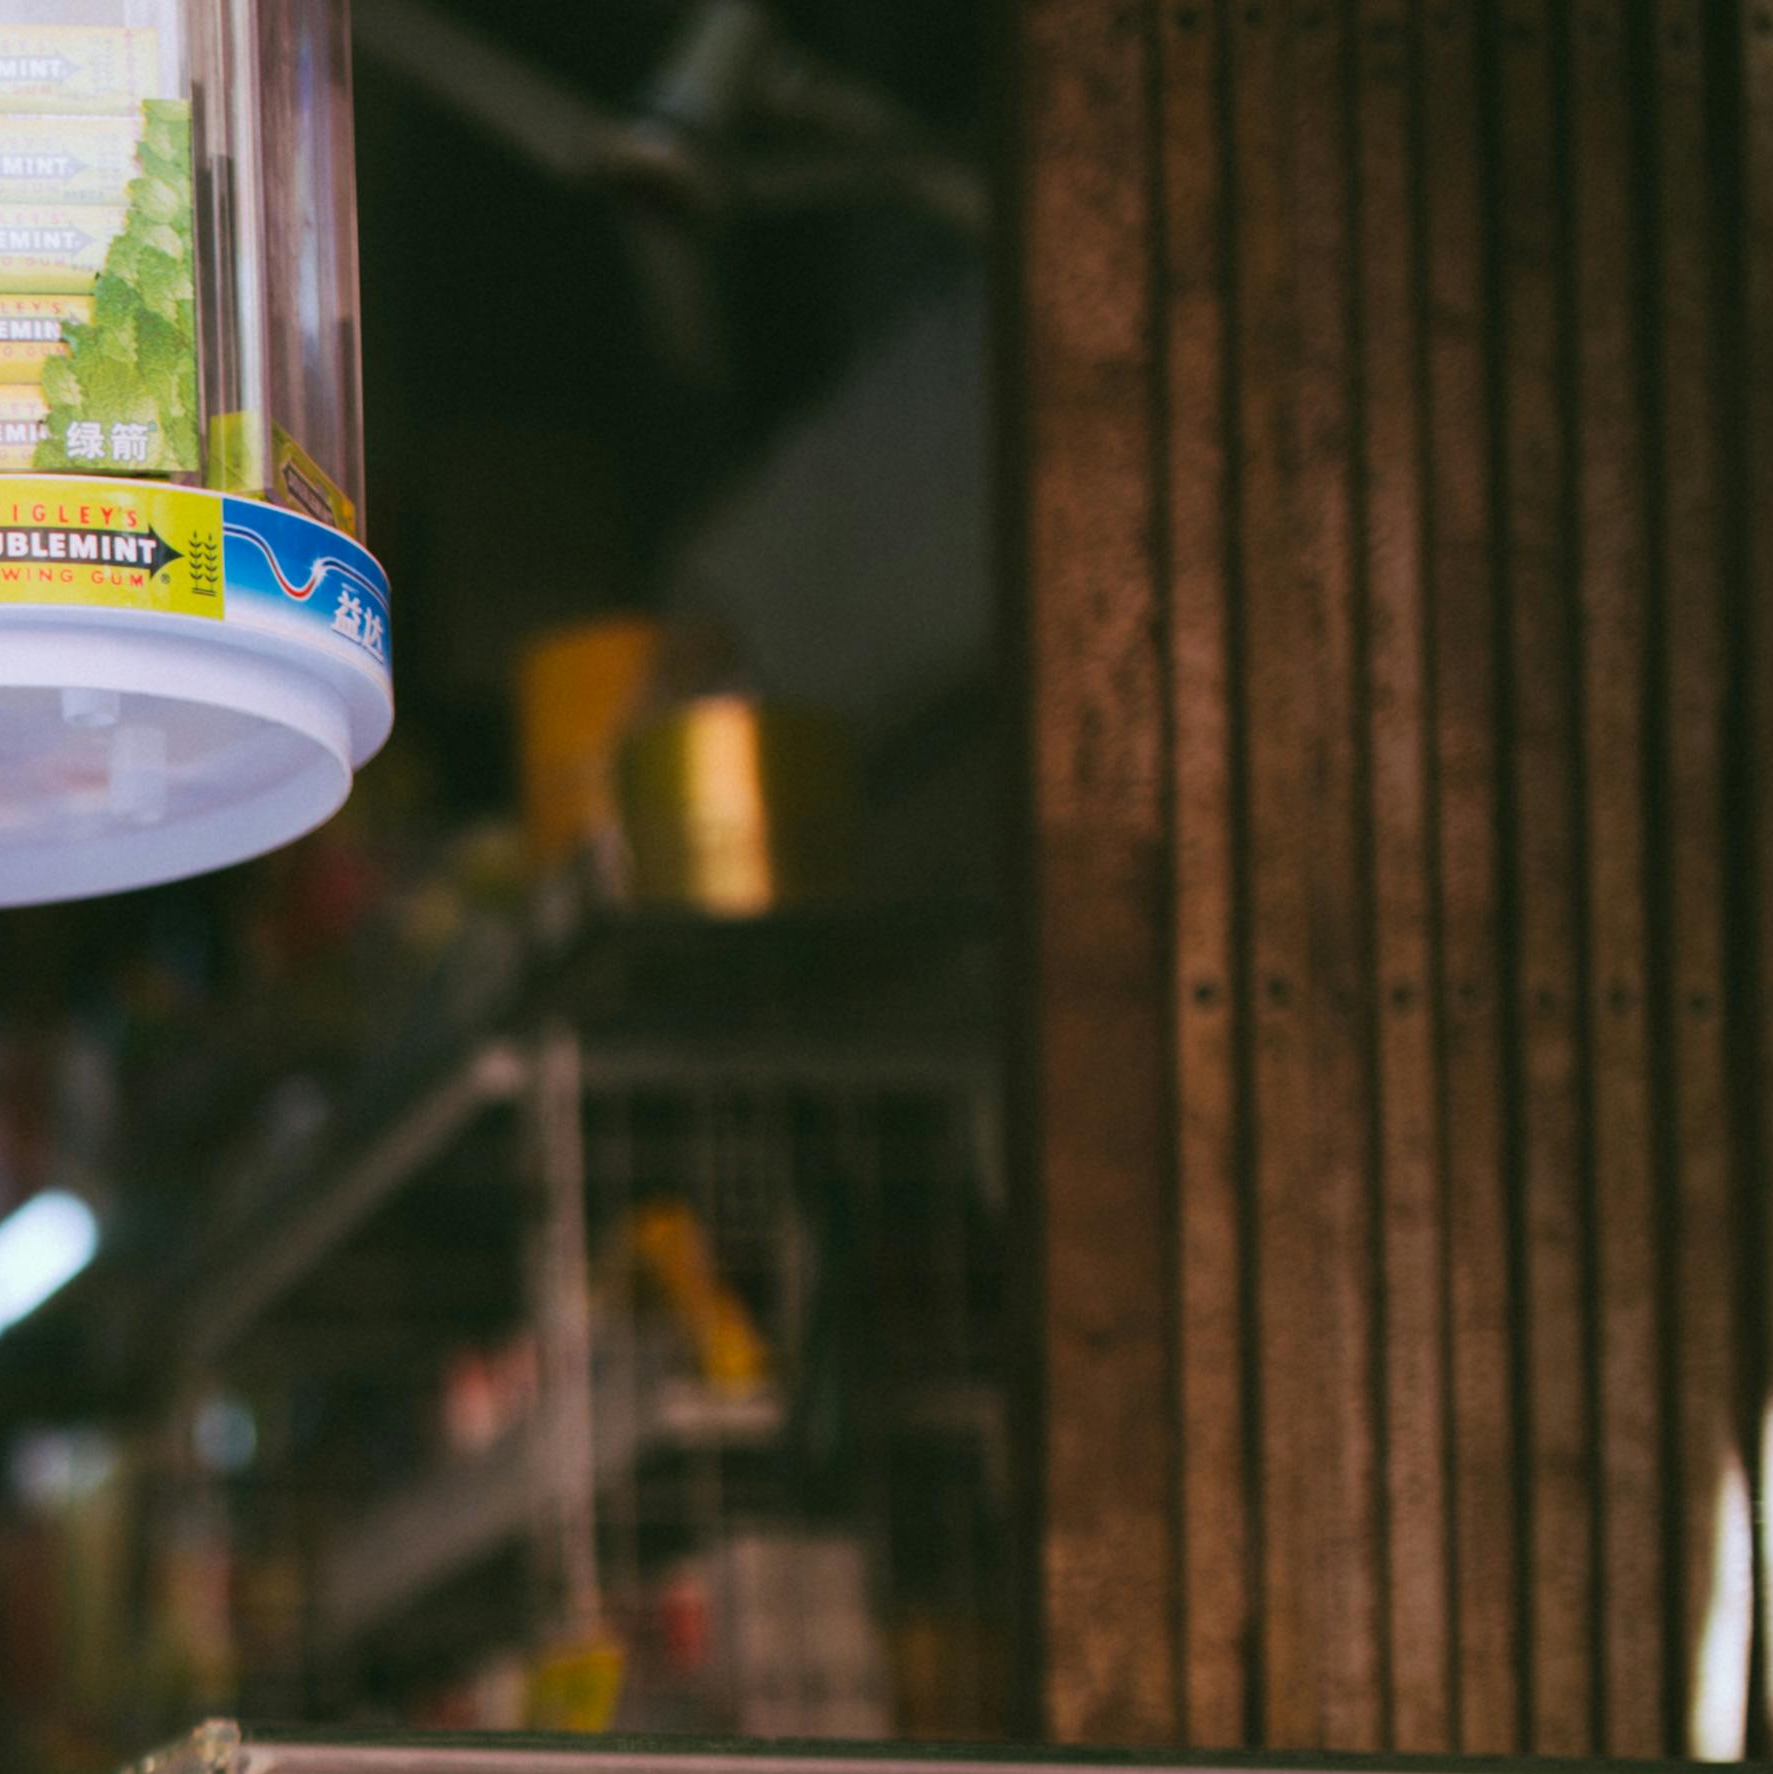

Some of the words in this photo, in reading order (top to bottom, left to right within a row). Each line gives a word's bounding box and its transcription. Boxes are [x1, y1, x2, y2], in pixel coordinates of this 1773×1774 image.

[65, 421, 150, 461] 绿箭
[91, 570, 145, 587] GUM
[331, 590, 385, 665] 益达
